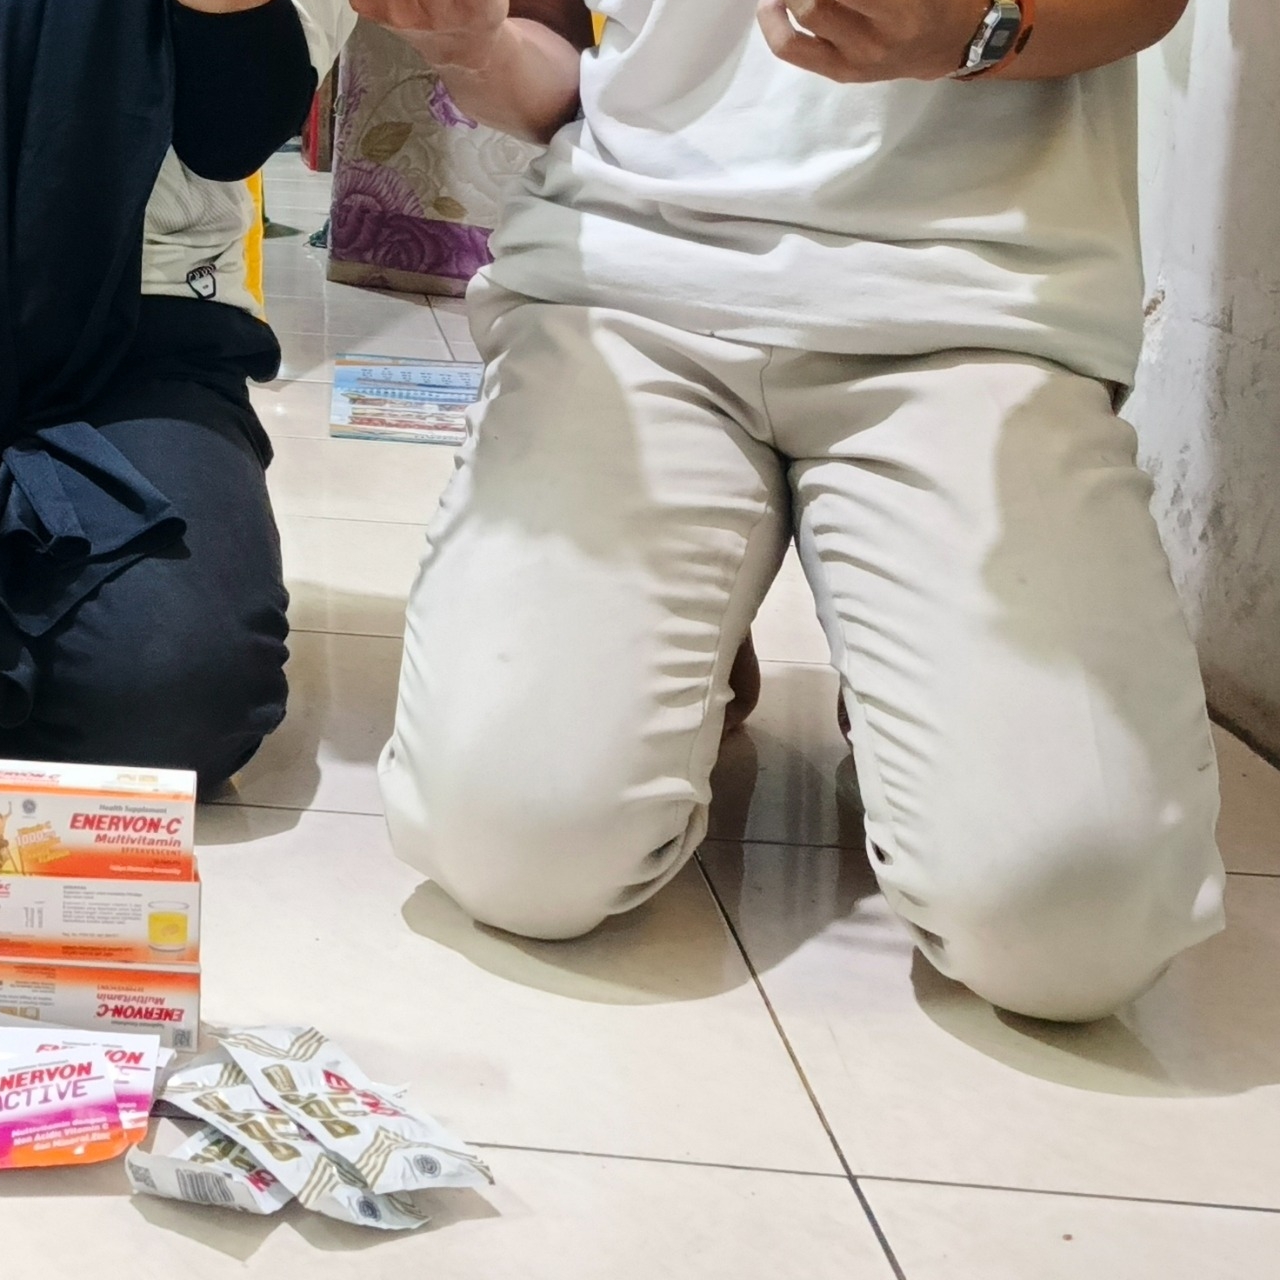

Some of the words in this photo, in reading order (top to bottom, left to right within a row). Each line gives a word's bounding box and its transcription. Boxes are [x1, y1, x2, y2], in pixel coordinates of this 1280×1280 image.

[99, 804, 123, 812] Health
[124, 805, 167, 814] Supplement
[70, 813, 182, 835] ENERVON-C
[94, 833, 181, 847] Multivitamin
[97, 993, 166, 1006] Multivitamin
[95, 1004, 185, 1023] ENERVON-C
